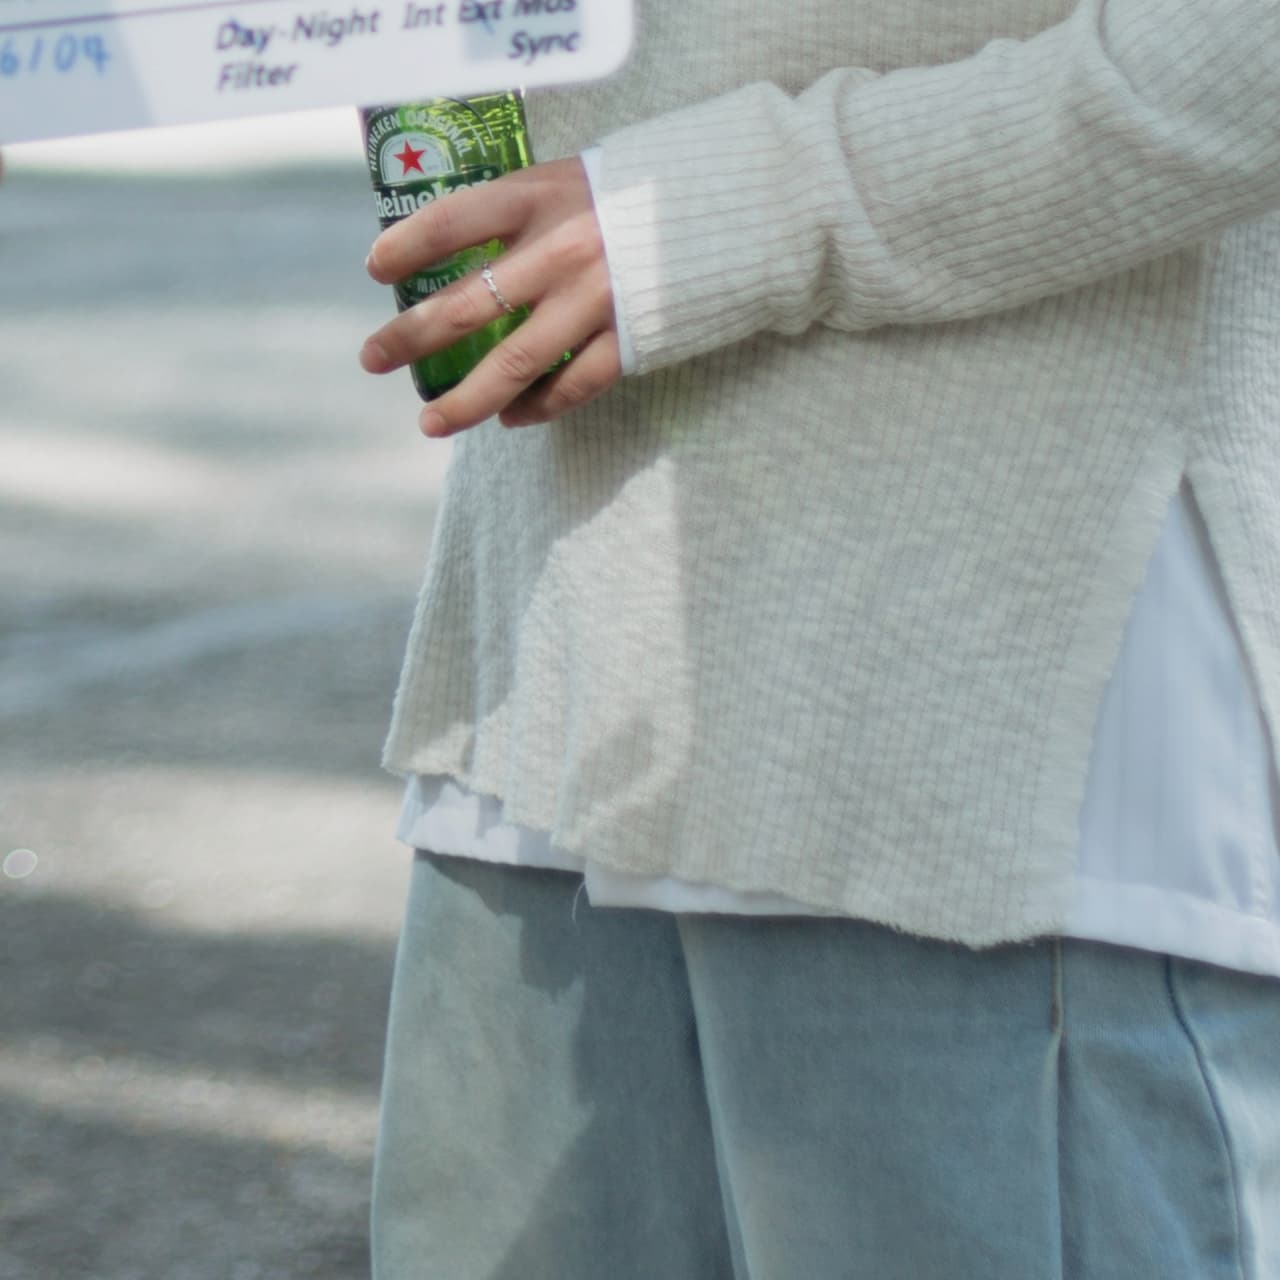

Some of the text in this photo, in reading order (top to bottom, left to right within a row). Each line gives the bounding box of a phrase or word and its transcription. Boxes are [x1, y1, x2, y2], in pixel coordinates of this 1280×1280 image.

[402, 1, 446, 30] Int
[509, 29, 580, 66] Sync
[220, 62, 299, 92] Filter
[369, 108, 472, 172] HEINEKEN ORIGINAL
[374, 180, 489, 219] Heinek
